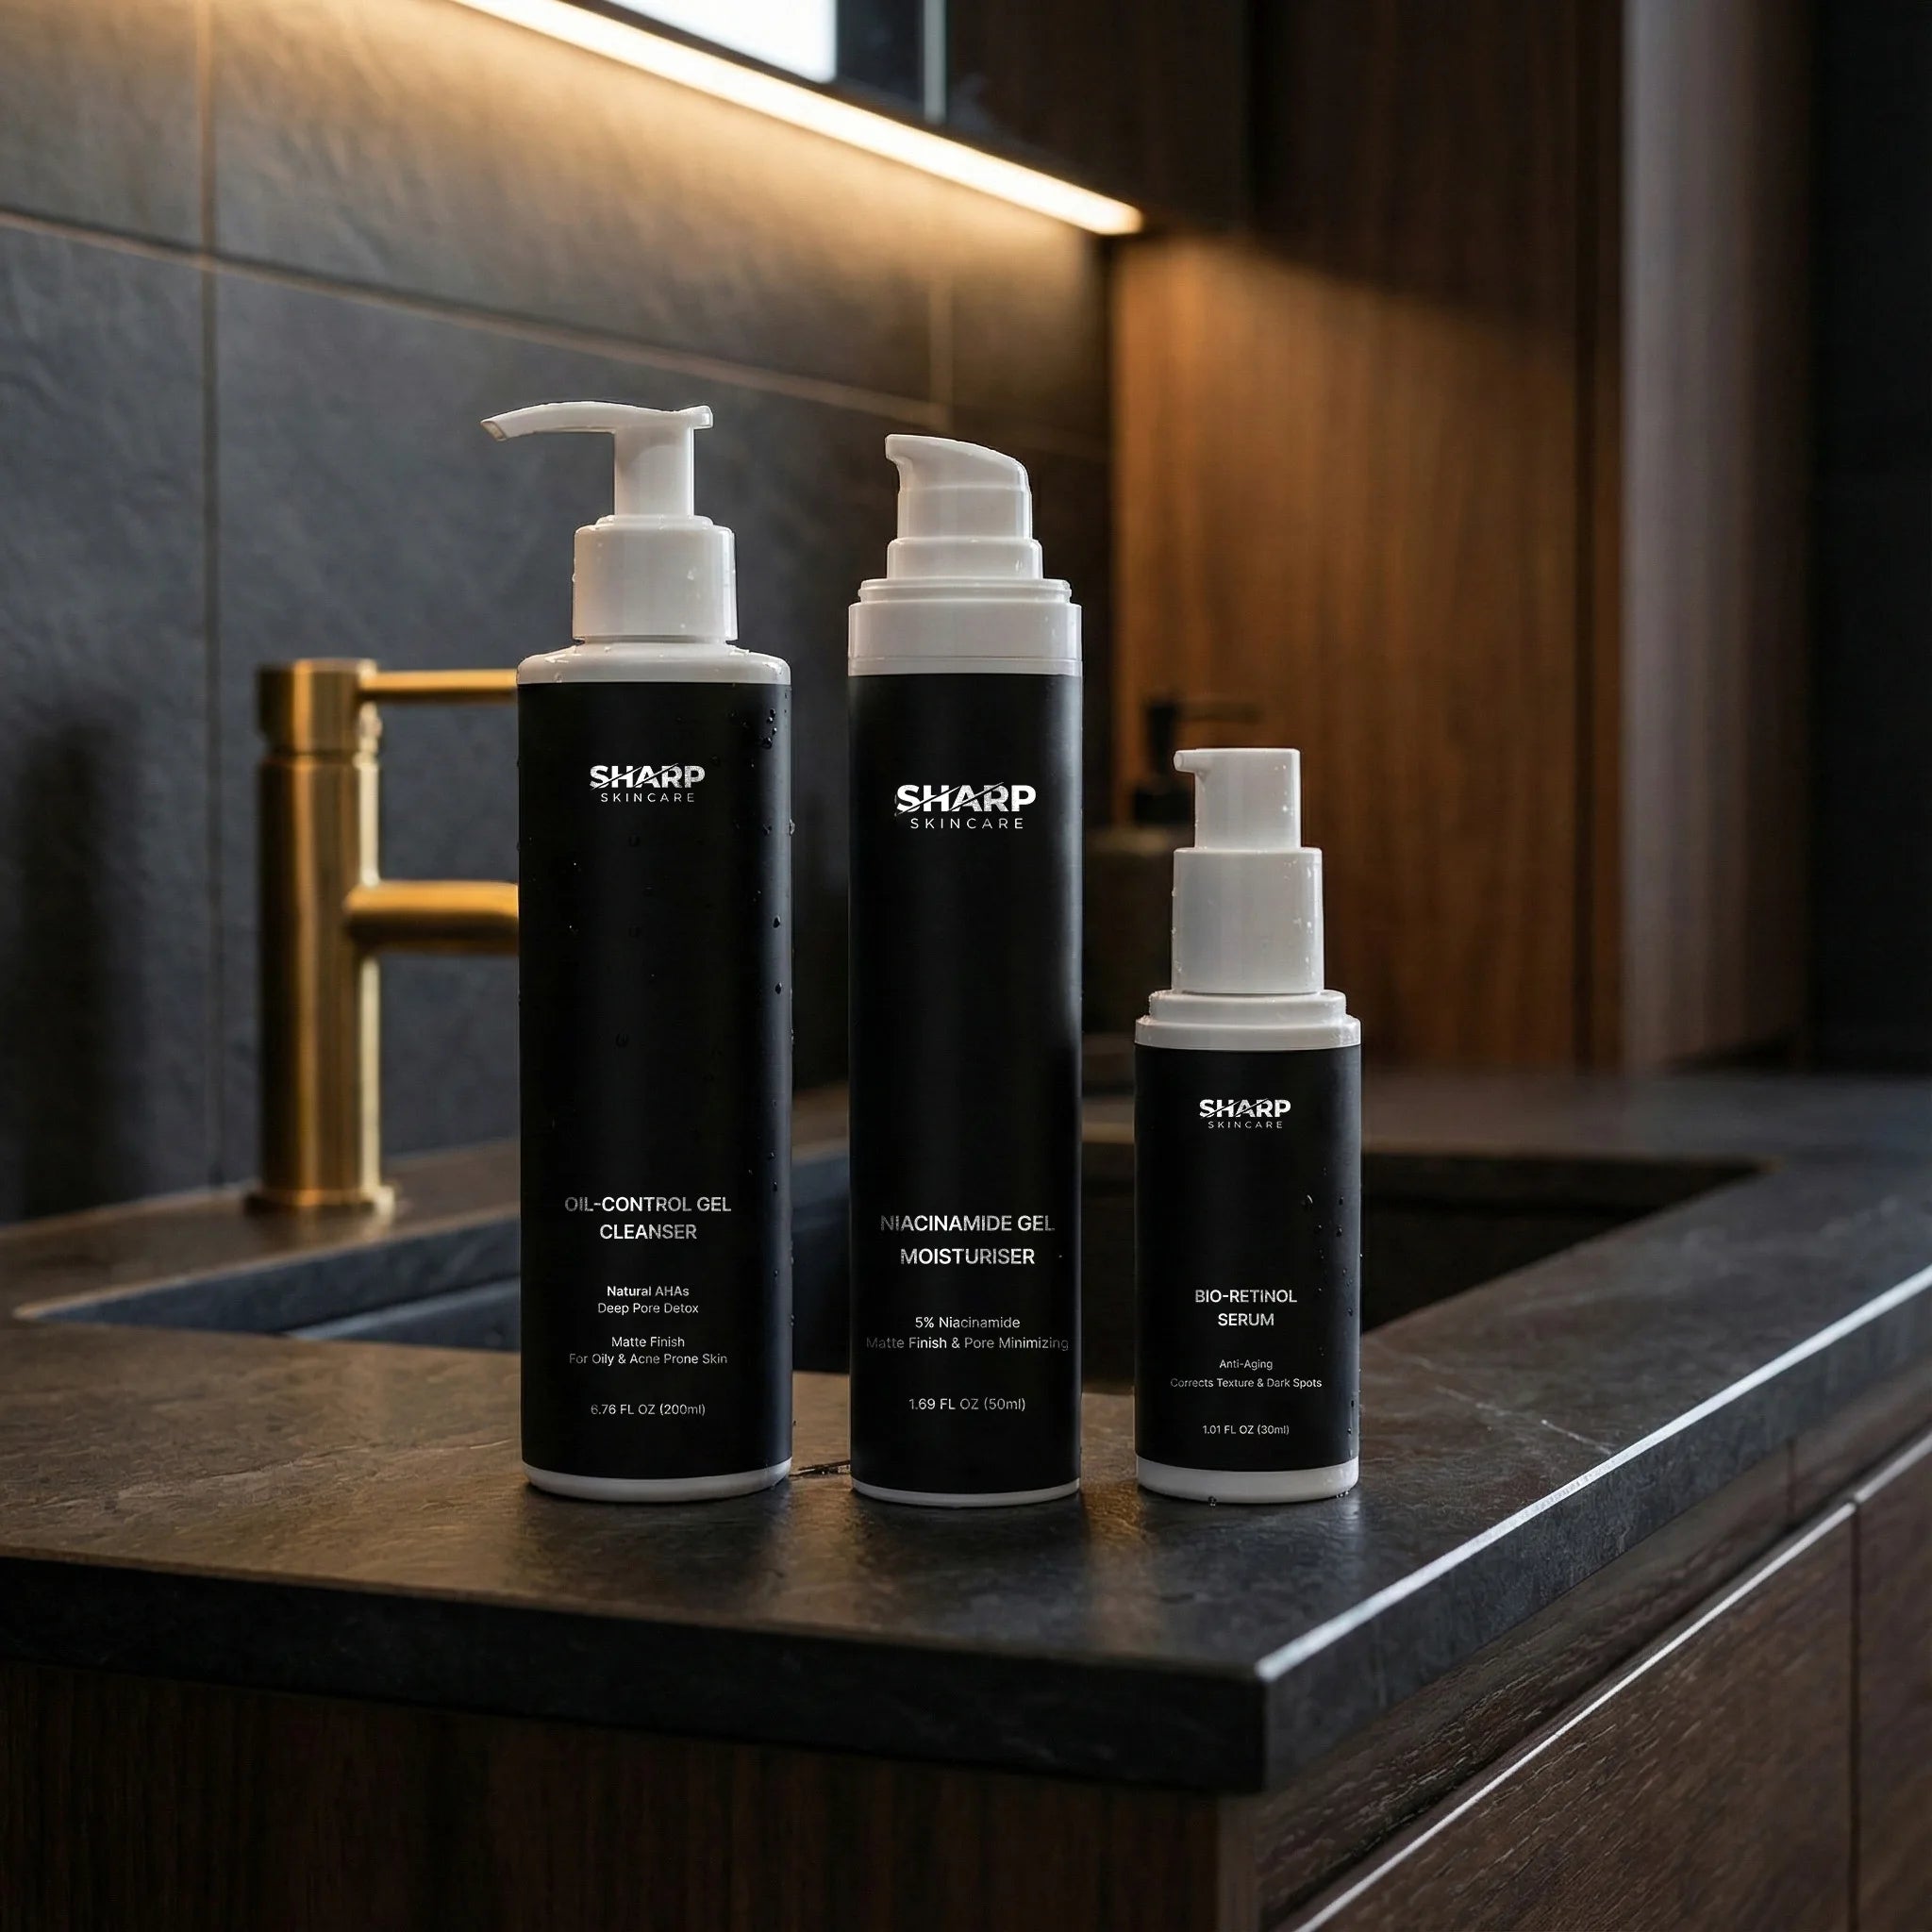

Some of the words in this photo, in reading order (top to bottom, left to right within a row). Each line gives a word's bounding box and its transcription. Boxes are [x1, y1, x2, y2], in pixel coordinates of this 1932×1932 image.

[590, 762, 706, 790] SHARP
[600, 792, 694, 803] SKINCARE
[894, 782, 1037, 815] SHARP
[910, 818, 1024, 829] SKINCARE
[1199, 1098, 1291, 1119] SHARP
[1208, 1121, 1283, 1129] SKINCARE
[564, 1196, 692, 1212] OIL-CONTROL
[696, 1196, 732, 1212] GEL
[880, 1214, 1012, 1232] NIACINAMIDE
[1017, 1214, 1056, 1232] GEL
[599, 1224, 698, 1240] CLEANSER
[900, 1247, 1036, 1265] MOISTURISER
[607, 1285, 652, 1297] Natural
[655, 1285, 690, 1297] AHAs
[1194, 1289, 1298, 1304] BIO-RETINOL
[597, 1302, 630, 1316] Deep
[632, 1302, 660, 1314] Pore
[663, 1302, 699, 1314] Detox
[915, 1316, 935, 1329] 5%
[939, 1316, 1021, 1329] Niacinamide
[1217, 1312, 1274, 1327] SERUM
[611, 1336, 647, 1348] Matte
[650, 1336, 685, 1348] Finish
[866, 1336, 905, 1349] Matte
[908, 1336, 947, 1349] Finish
[951, 1337, 960, 1349] &
[964, 1337, 994, 1349] Pore
[998, 1336, 1069, 1352] Minimizing
[569, 1353, 589, 1365] For
[591, 1353, 615, 1367] Oily
[617, 1353, 626, 1365] &
[629, 1353, 660, 1365] Acne
[663, 1353, 699, 1365] Prone
[702, 1353, 728, 1365] Skin
[1219, 1358, 1274, 1372] Anti-Aging
[1170, 1377, 1214, 1389] Corrects
[1216, 1377, 1255, 1389] Texture
[1257, 1377, 1264, 1389] &
[1266, 1377, 1291, 1389] Dark
[1292, 1377, 1323, 1390] Spots
[591, 1404, 617, 1416] 6.76
[620, 1404, 635, 1416] FL
[638, 1404, 656, 1416] OZ
[659, 1403, 706, 1417] (200ml)
[908, 1398, 936, 1411] 1.69
[940, 1398, 956, 1410] FL
[959, 1398, 979, 1410] OZ
[984, 1397, 1026, 1412] (50ml)
[1202, 1424, 1221, 1435] 1.01
[1224, 1424, 1237, 1435] FL
[1239, 1424, 1255, 1435] OZ
[1257, 1424, 1290, 1437] (30ml)
